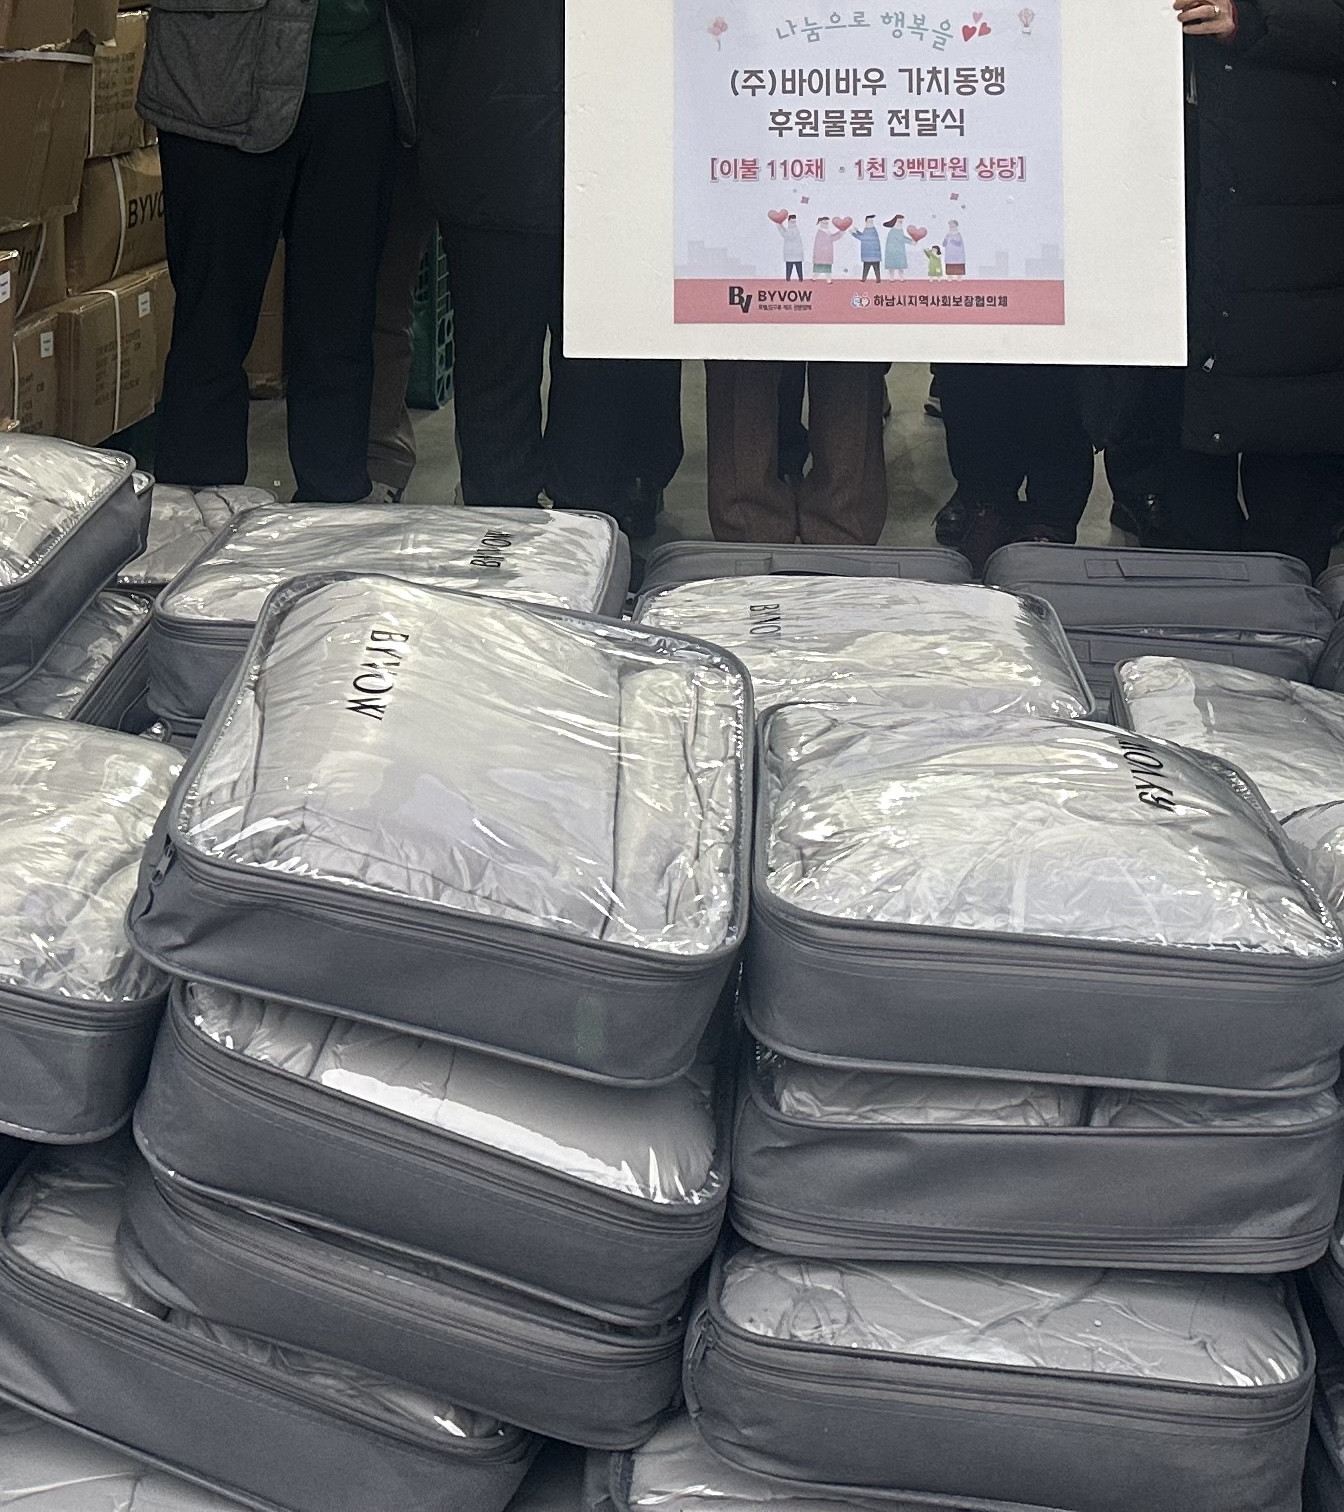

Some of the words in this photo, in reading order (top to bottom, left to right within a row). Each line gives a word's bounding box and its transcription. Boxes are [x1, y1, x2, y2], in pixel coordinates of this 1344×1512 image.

[775, 10, 871, 44] 나눔으로
[878, 10, 955, 52] 행복을
[729, 67, 887, 98] (주)바이바우
[897, 64, 1008, 97] 가치동행
[768, 108, 875, 139] 후원물품
[886, 107, 967, 138] 전달식
[709, 155, 761, 183] [이불
[766, 155, 825, 181] 110채
[854, 155, 888, 181] 1천
[892, 155, 969, 182] 3백만원
[975, 155, 1027, 182] 상당]
[757, 290, 812, 302] BYVOW
[873, 294, 1009, 308] 하남시지역사회보장협의체
[345, 629, 410, 722] BYVOW
